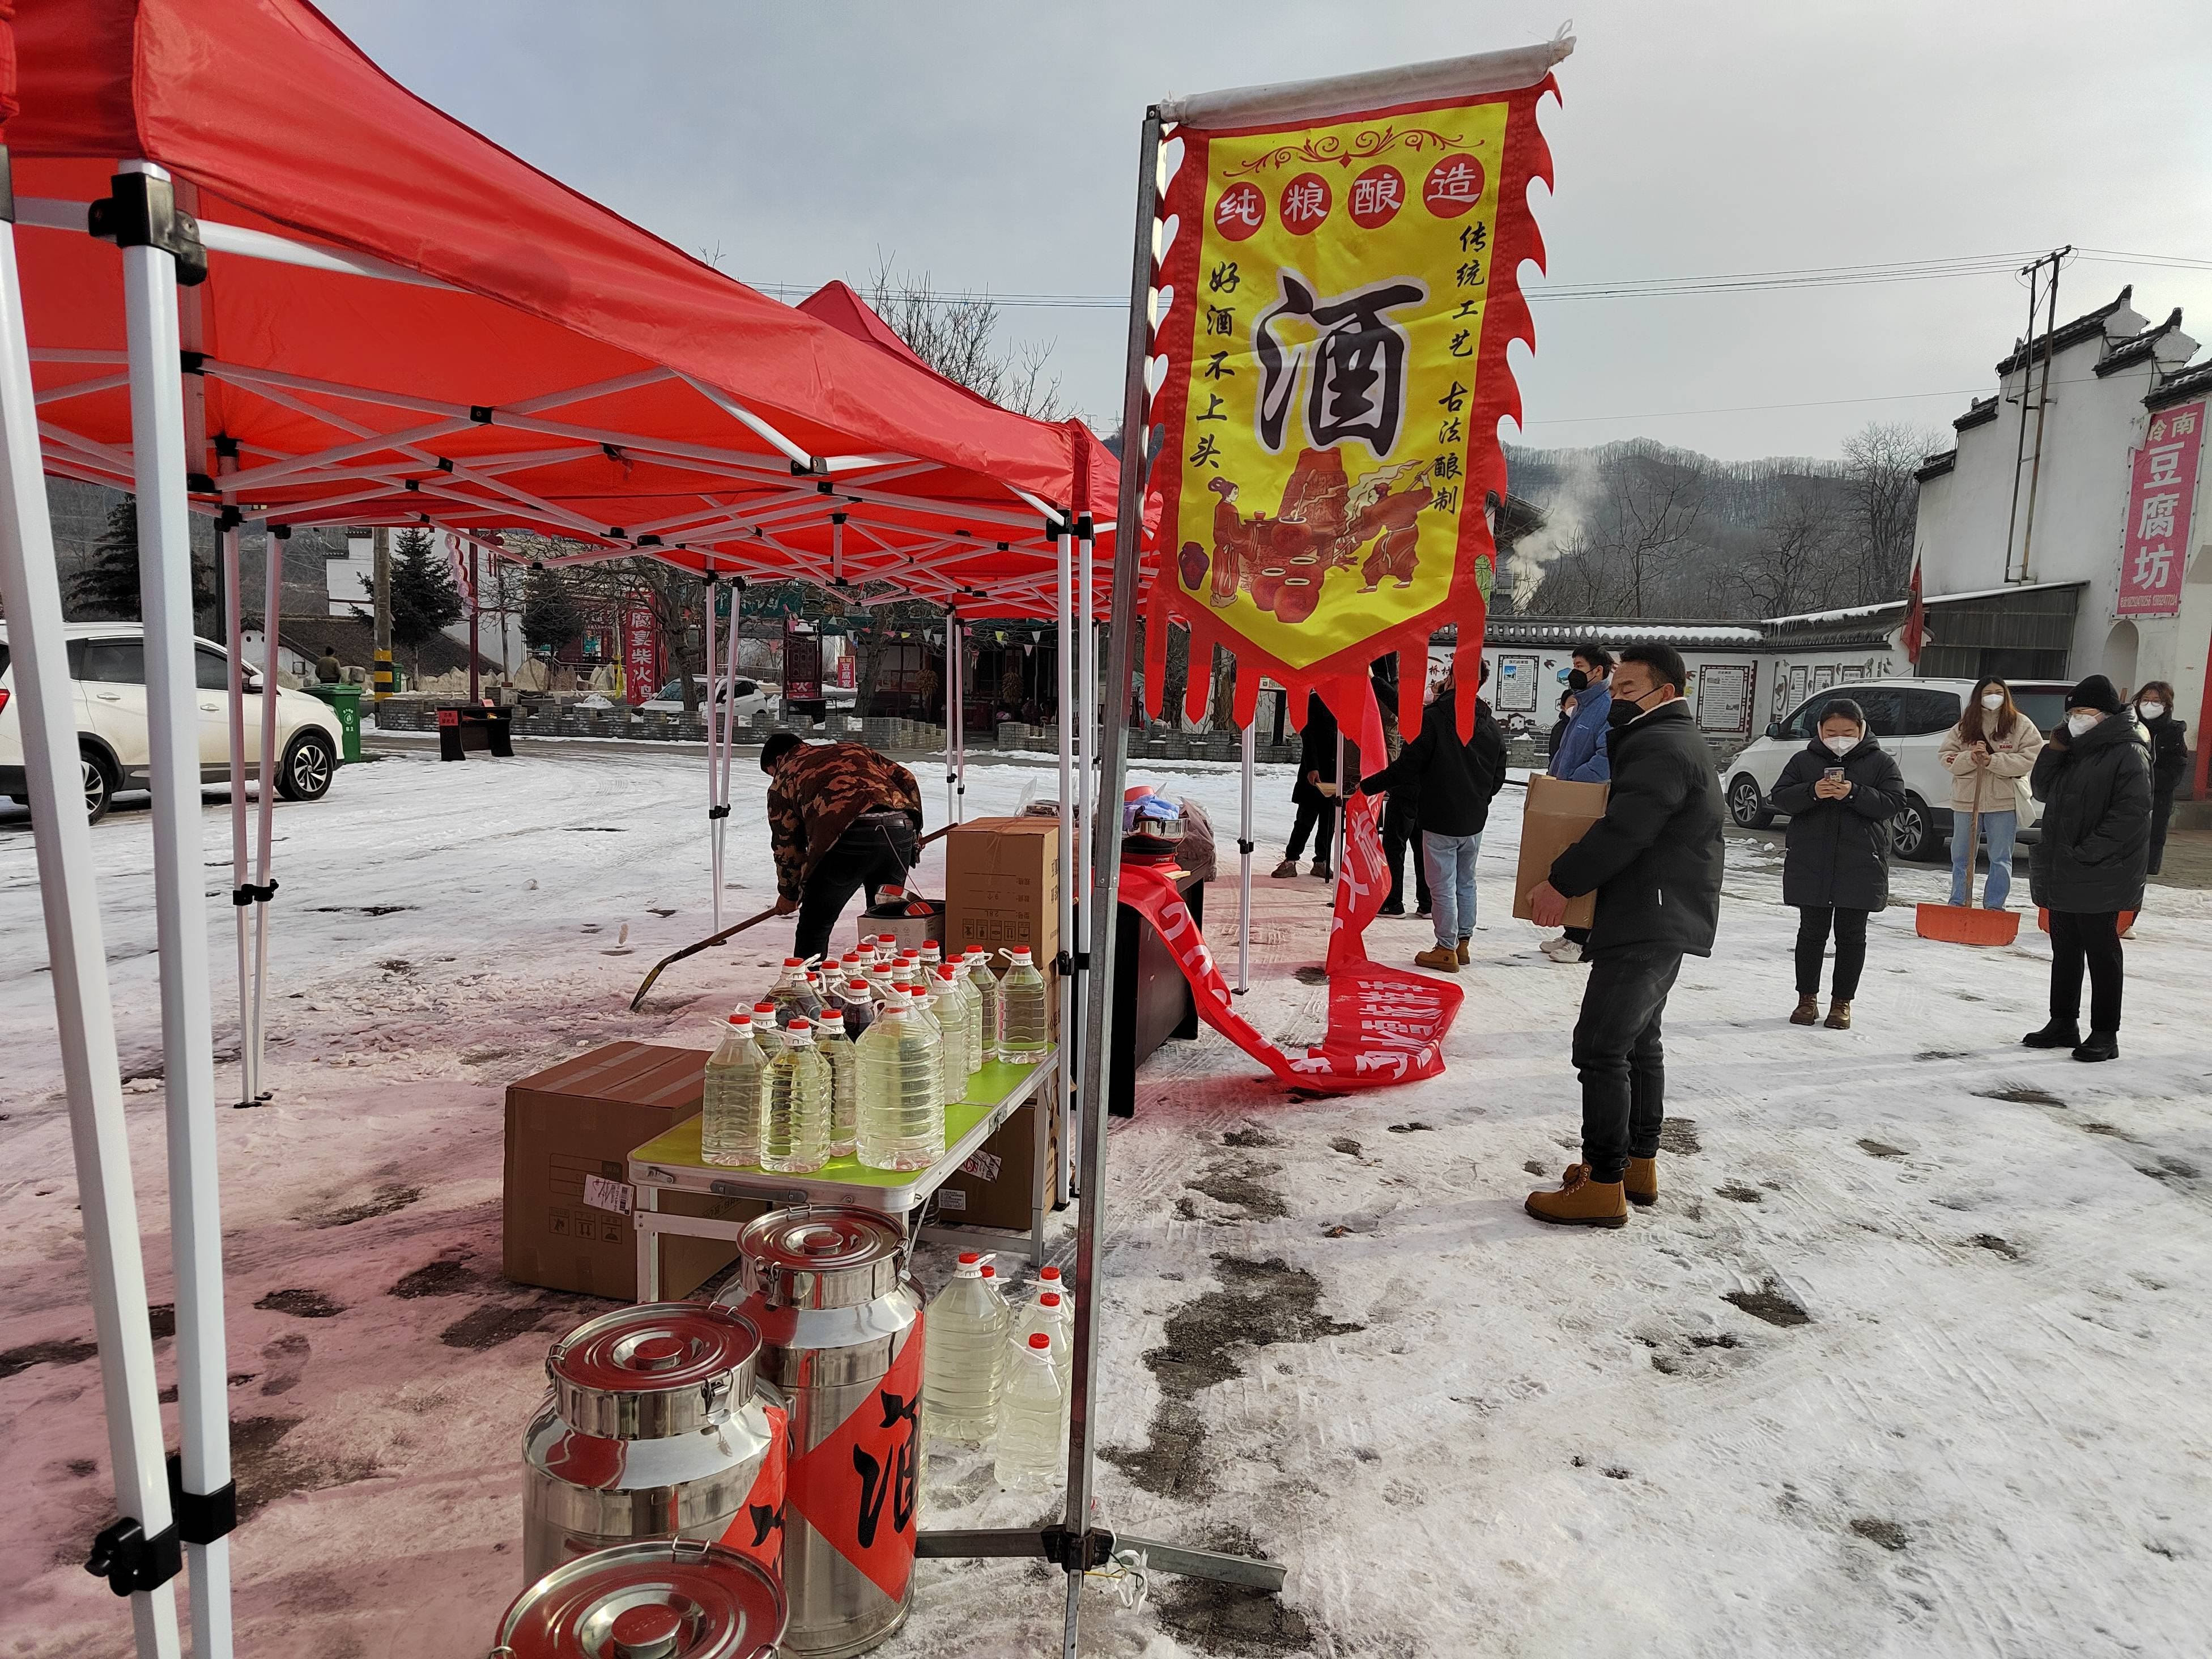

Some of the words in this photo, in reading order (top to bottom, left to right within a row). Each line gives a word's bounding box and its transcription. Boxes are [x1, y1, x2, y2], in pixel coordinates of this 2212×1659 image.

[1218, 163, 1481, 226] 纯粮酿造
[1449, 224, 1488, 358] 传统工艺
[1190, 261, 1240, 470] 好酒不上头
[1257, 274, 1425, 457] 酒
[1430, 381, 1467, 514] 古法酿制
[2133, 442, 2185, 590] 豆腐坊
